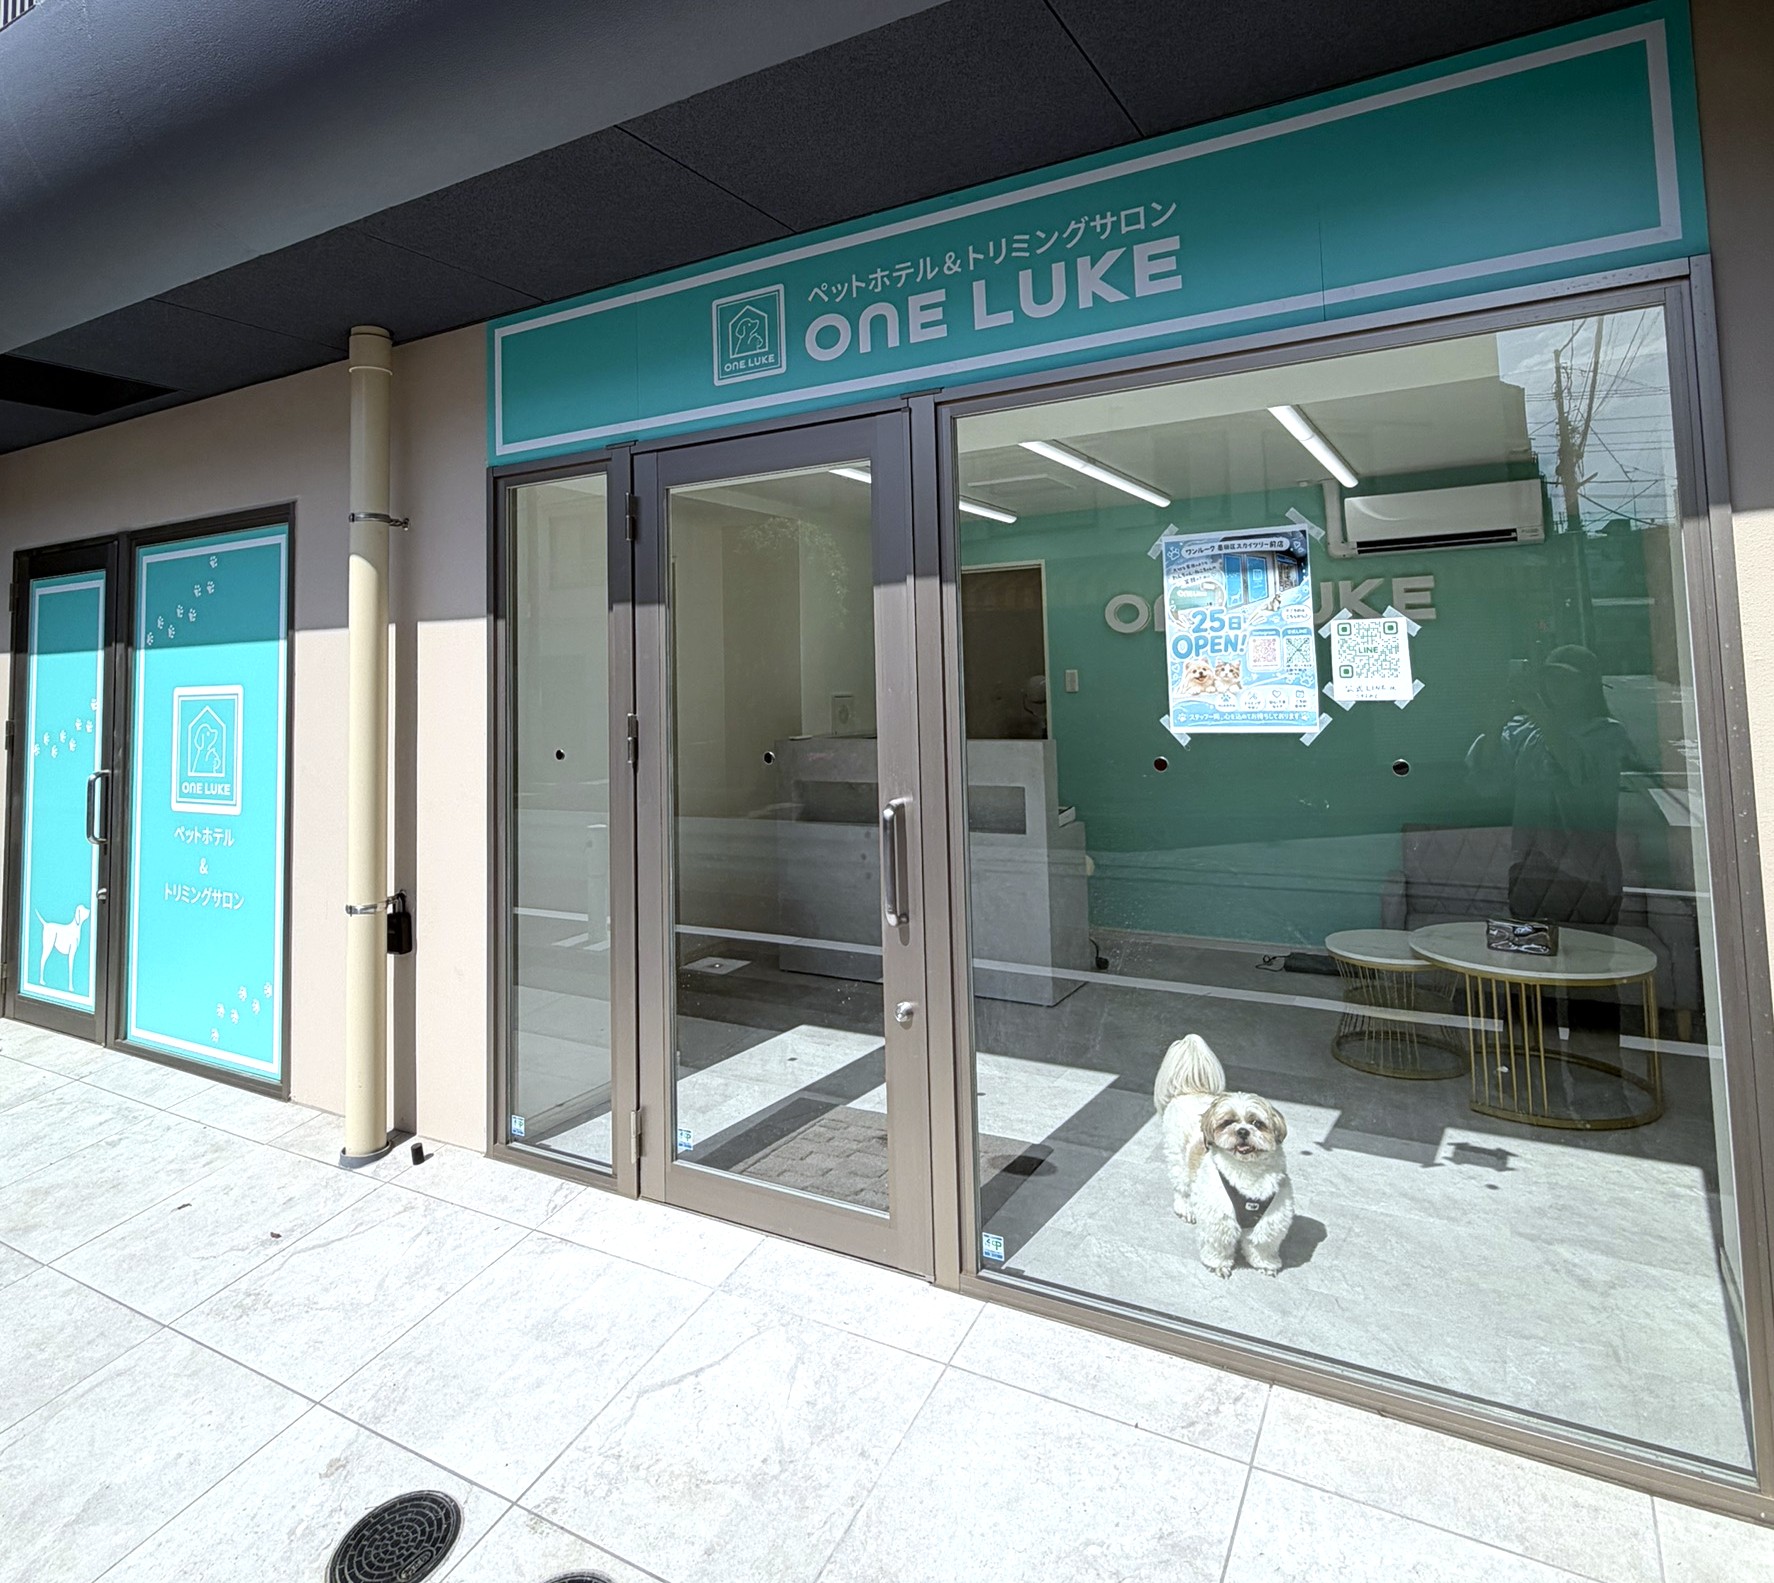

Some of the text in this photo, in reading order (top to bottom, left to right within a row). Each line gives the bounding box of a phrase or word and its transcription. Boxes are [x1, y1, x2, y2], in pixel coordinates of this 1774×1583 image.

[807, 202, 1178, 303] ペットホテル&トリミングサロン
[972, 236, 1182, 330] LUKE
[748, 354, 775, 367] LUKE
[1191, 608, 1242, 633] 25日
[1171, 634, 1248, 659] OPEN!
[205, 783, 231, 795] LUKE
[174, 825, 235, 847] ペットホテル
[199, 857, 209, 875] &
[164, 882, 245, 910] トリミングサロン
